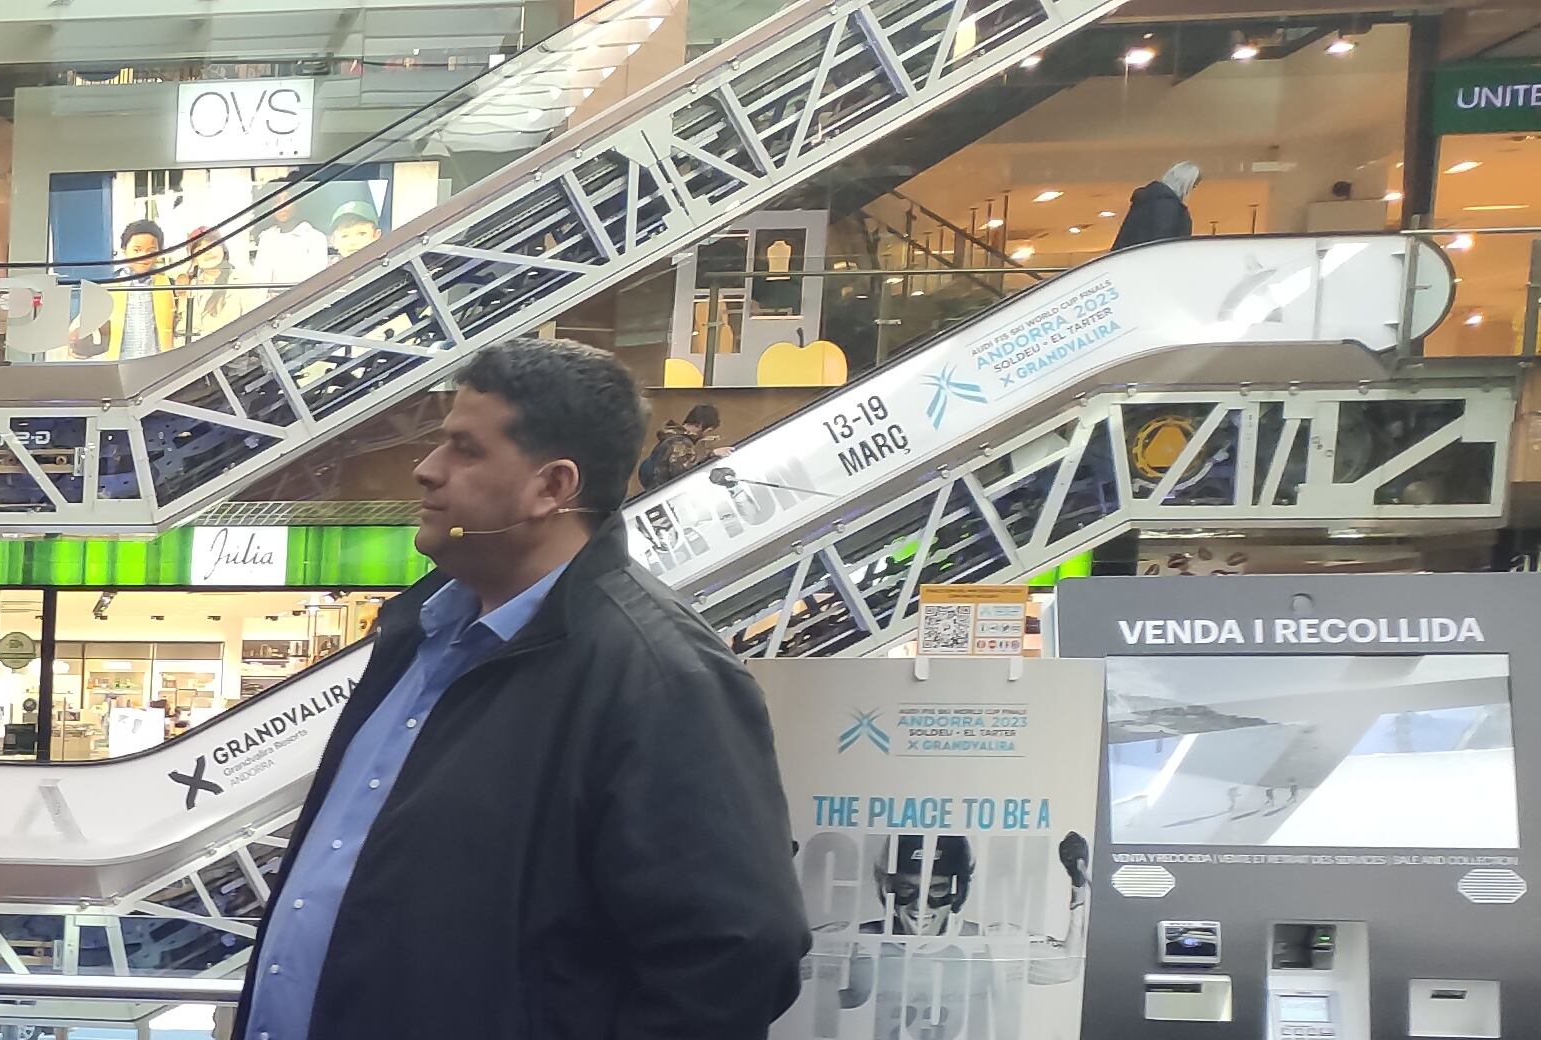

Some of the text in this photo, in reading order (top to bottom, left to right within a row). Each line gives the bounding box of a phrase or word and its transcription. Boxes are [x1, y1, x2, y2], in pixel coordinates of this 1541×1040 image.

[189, 88, 301, 138] OVS
[976, 287, 1120, 370] ANDORRA 2023
[1026, 307, 1059, 327] WORLD
[1060, 296, 1079, 310] CUP
[993, 307, 1114, 373] SOLDEU EL TARTER
[1016, 320, 1121, 379] GRANDVALIRA
[822, 394, 889, 445] 13-19
[837, 423, 910, 476] MARÇ
[1118, 616, 1485, 645] VENDA I RECOLLIDA
[213, 677, 360, 765] GRANDVALIRA
[897, 715, 1028, 727] ANDORRA 2023
[813, 796, 1050, 830] THE PLACE TO BE A
